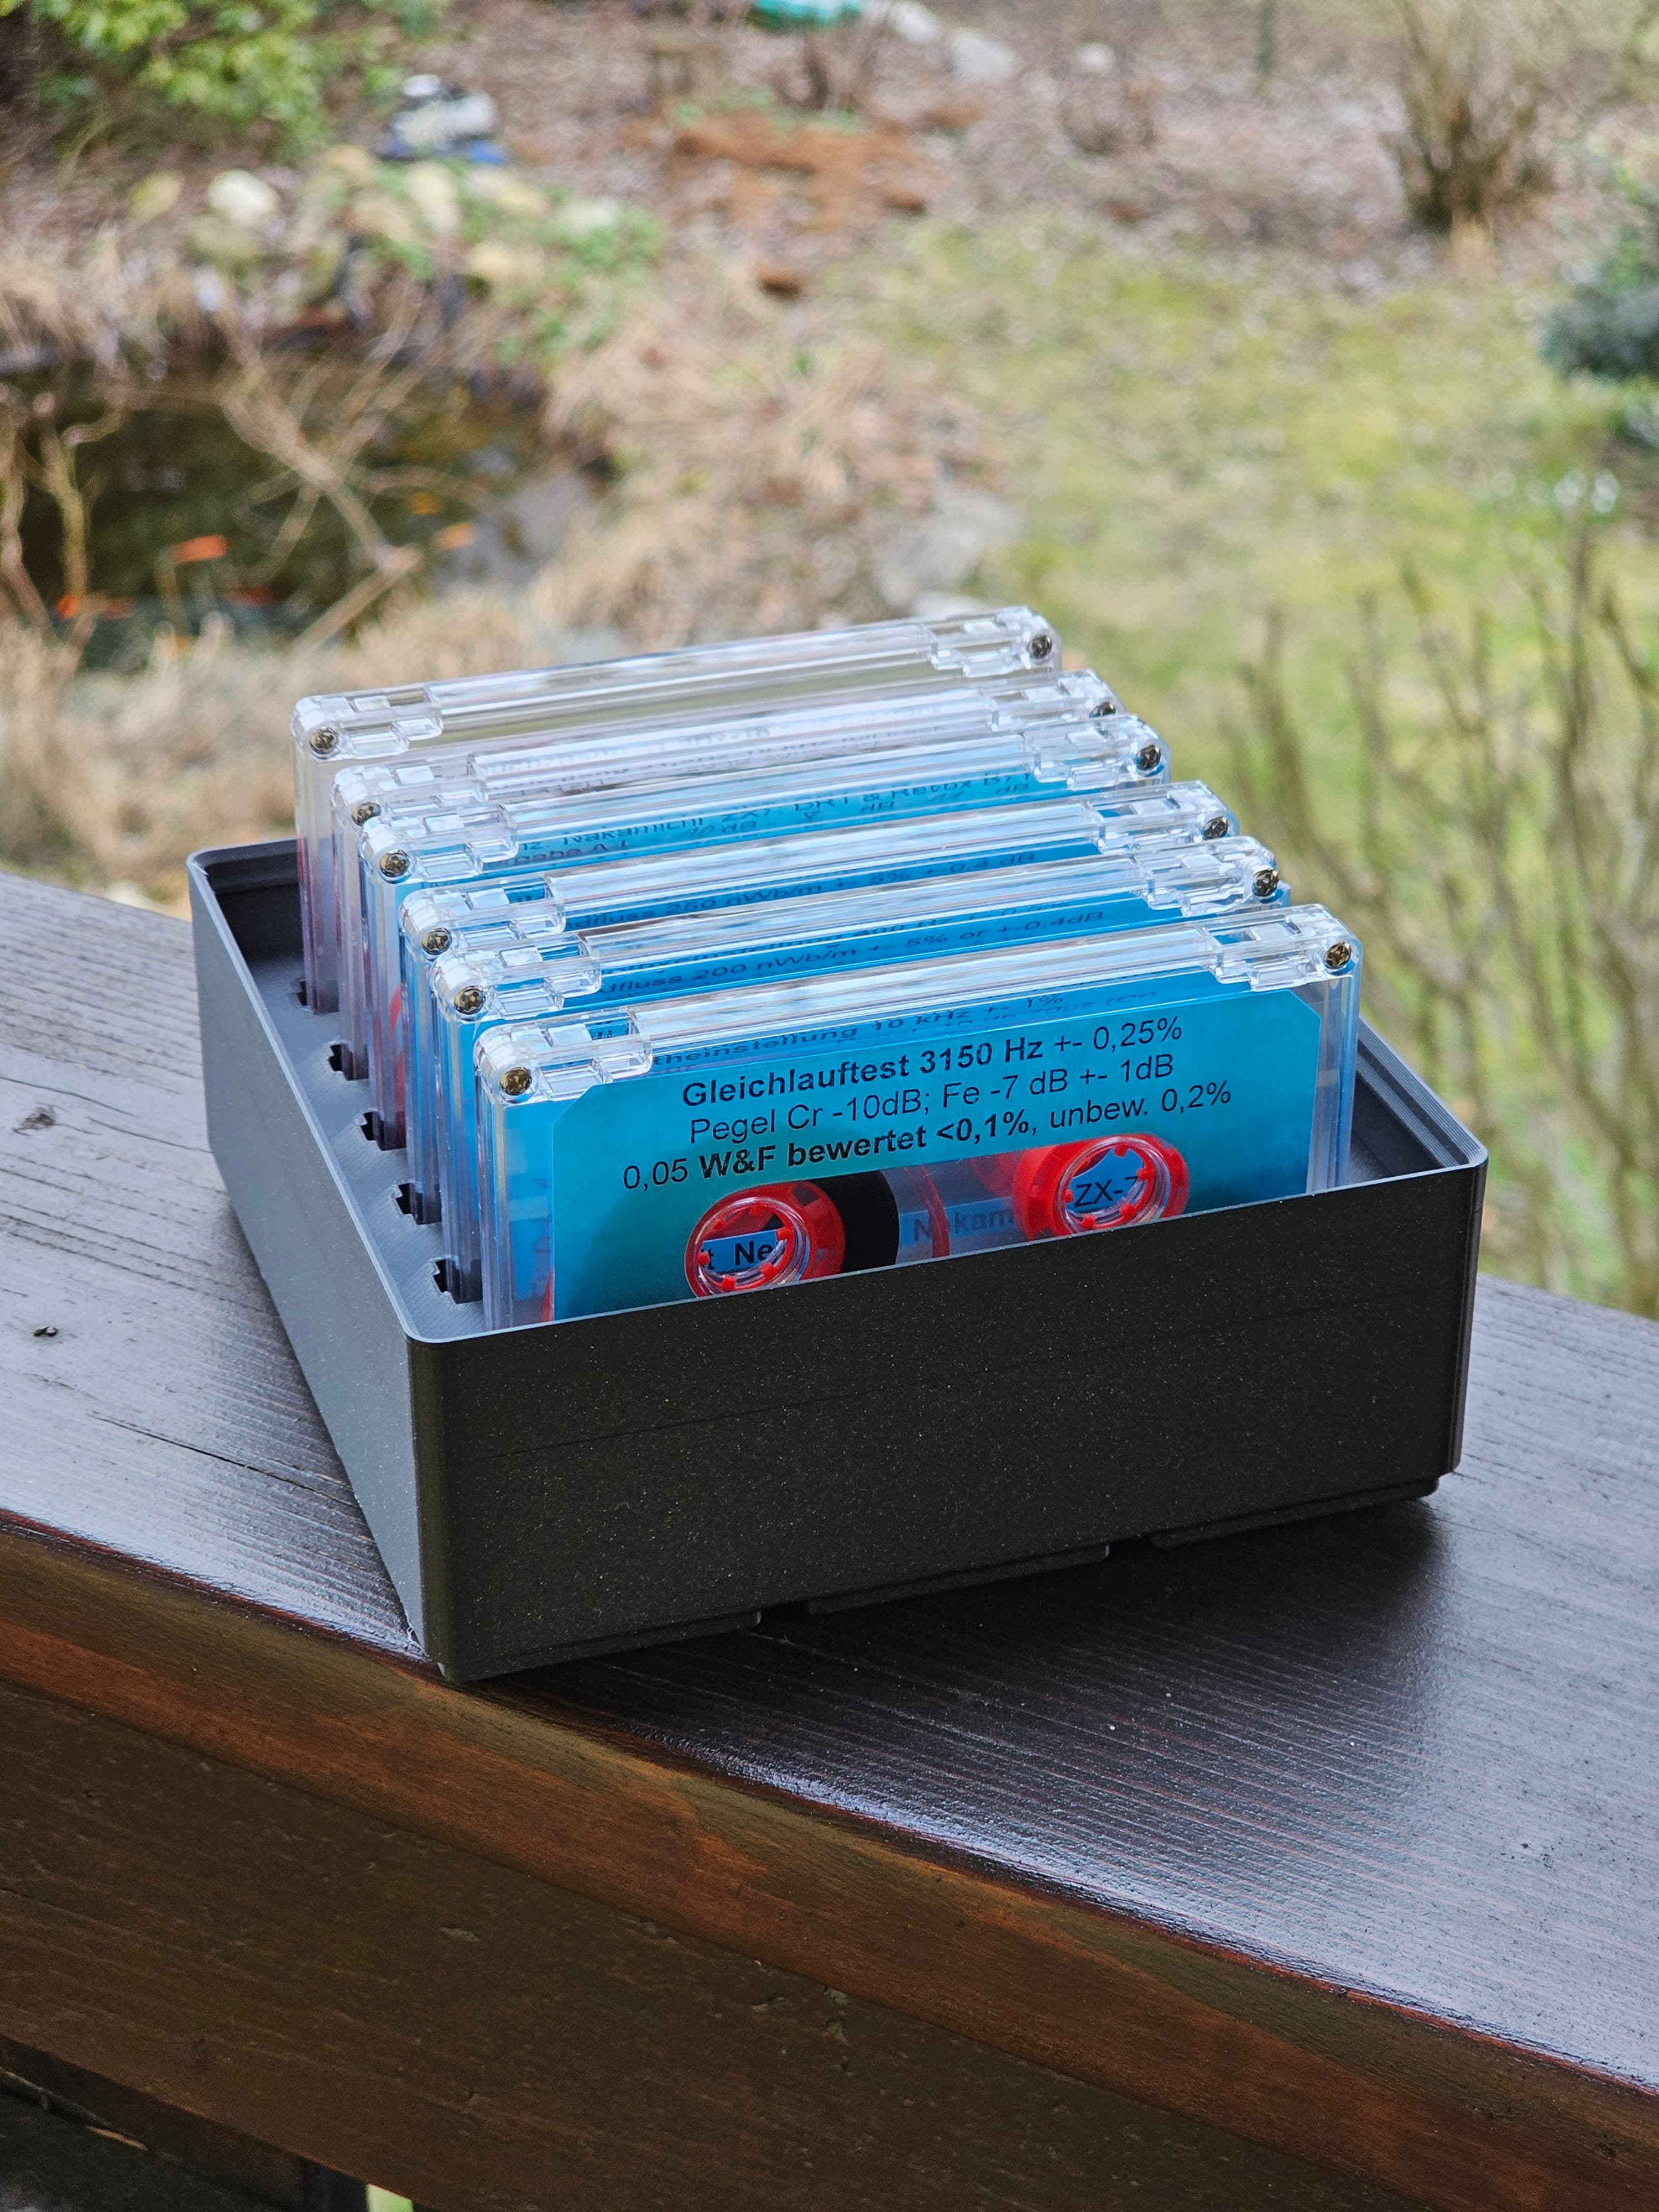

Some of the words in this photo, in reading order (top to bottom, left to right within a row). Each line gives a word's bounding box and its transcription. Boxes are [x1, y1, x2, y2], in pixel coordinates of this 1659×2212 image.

[693, 963, 747, 980] 200
[757, 948, 857, 970] nWb/m
[904, 933, 948, 947] 5%
[959, 930, 988, 940] or
[872, 1018, 904, 1031] 10
[915, 1009, 971, 1025] kHz
[1022, 995, 1063, 1008] 1%
[682, 1054, 910, 1107] Gleichlauftest
[919, 1042, 993, 1074] 3150
[1004, 1037, 1044, 1063] Hz
[1054, 1035, 1083, 1052] +-
[1093, 1016, 1182, 1053] 0,25%
[690, 1108, 776, 1145] Pegel
[787, 1103, 823, 1130] Cr
[832, 1087, 930, 1121] -10dB;
[943, 1081, 980, 1108] Fe
[990, 1074, 1019, 1100] -7
[1029, 1068, 1068, 1096] dB
[1079, 1068, 1108, 1086] +-
[1120, 1053, 1173, 1083] 1dB
[623, 1158, 688, 1192] 0,05
[698, 1145, 776, 1179] W&F
[787, 1124, 927, 1167] bewertet
[936, 1108, 1037, 1144] <0,1%,
[1050, 1097, 1149, 1129] unbew.
[1161, 1079, 1232, 1115] 0,2%
[914, 1207, 1015, 1242] Nkam
